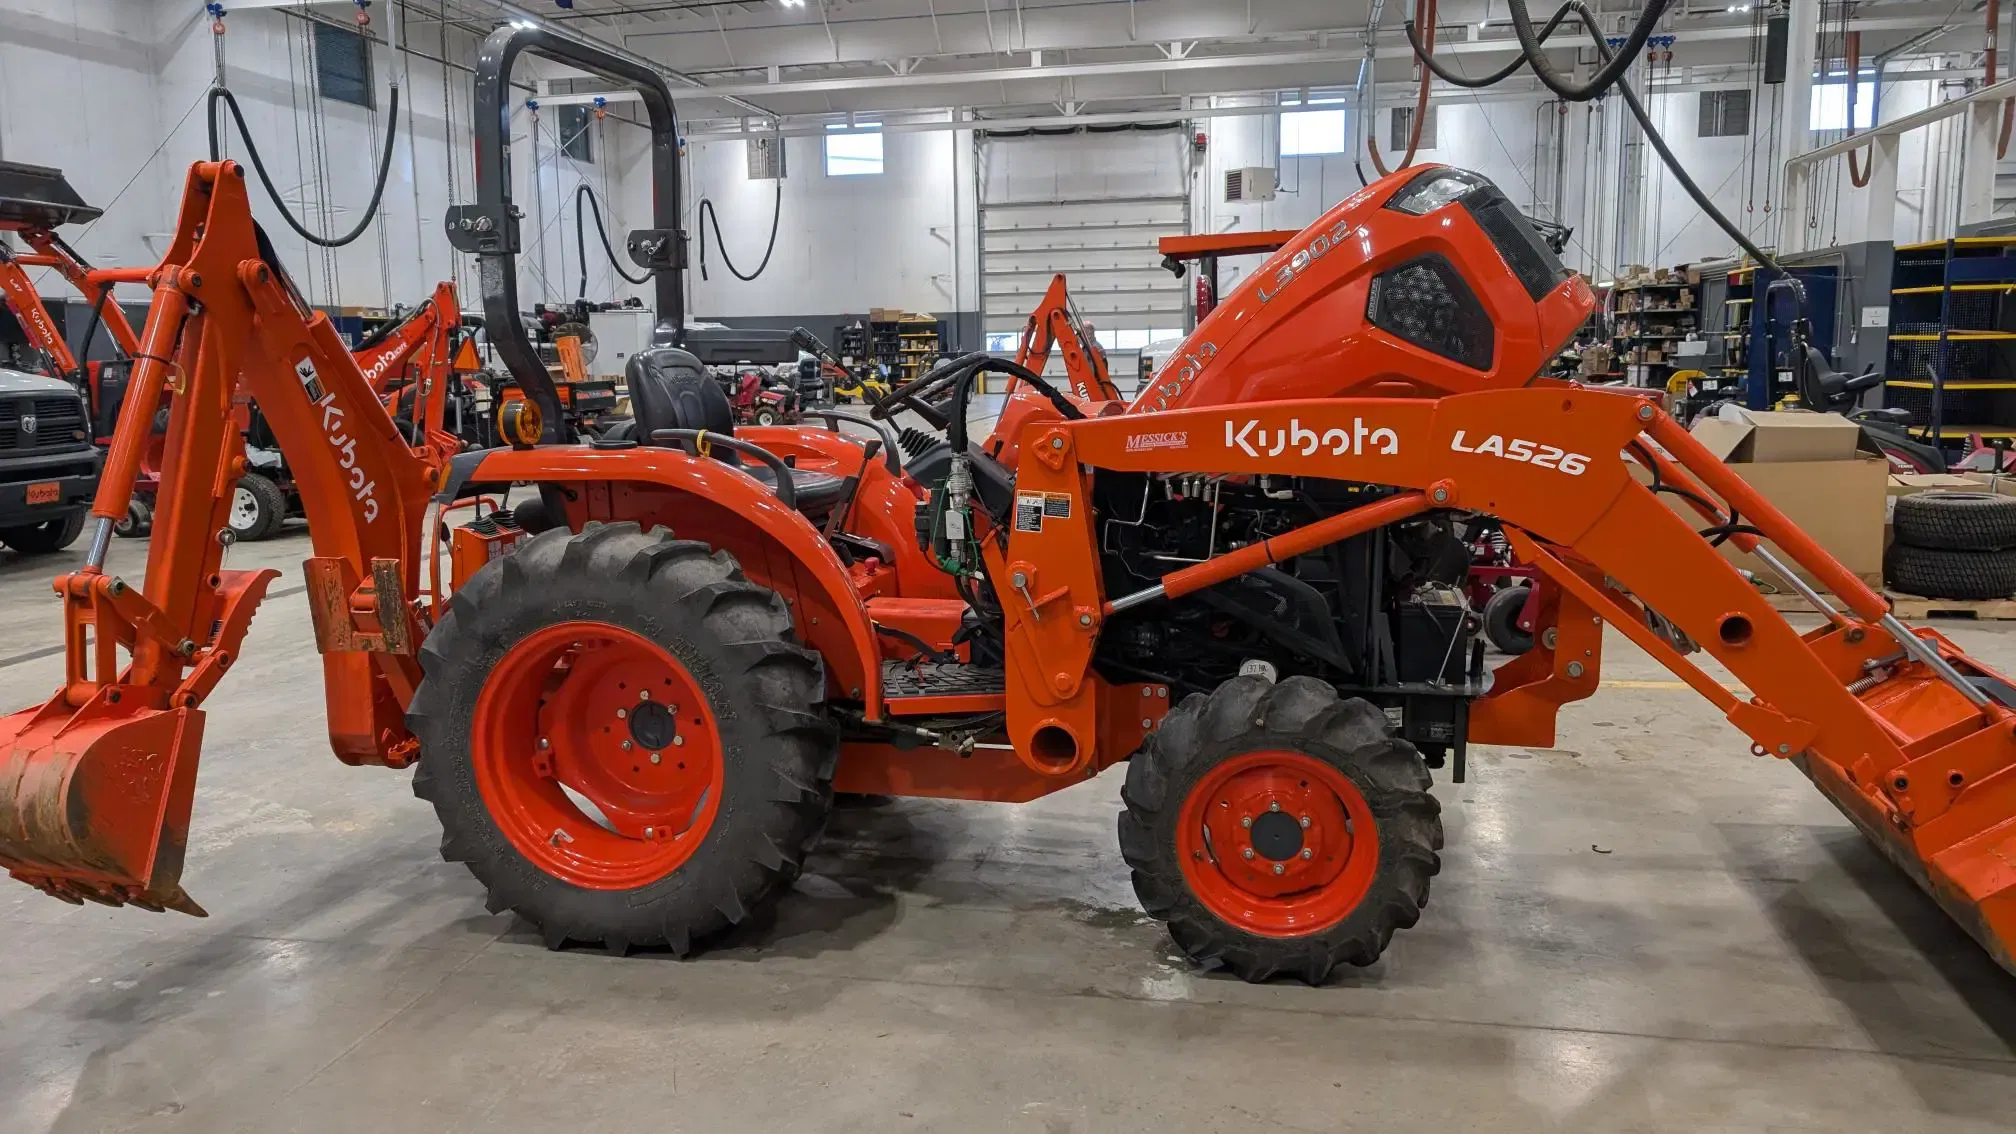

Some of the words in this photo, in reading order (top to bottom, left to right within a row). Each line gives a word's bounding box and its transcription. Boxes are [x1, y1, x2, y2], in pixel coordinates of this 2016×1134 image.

[1257, 220, 1351, 304] L3902
[31, 307, 53, 345] Kubota
[363, 350, 396, 379] bota
[1141, 341, 1218, 415] ubota
[319, 391, 380, 524] Kubota
[1125, 431, 1188, 449] MESSICK'S
[1225, 416, 1399, 457] Kubota
[1450, 430, 1592, 476] LA526
